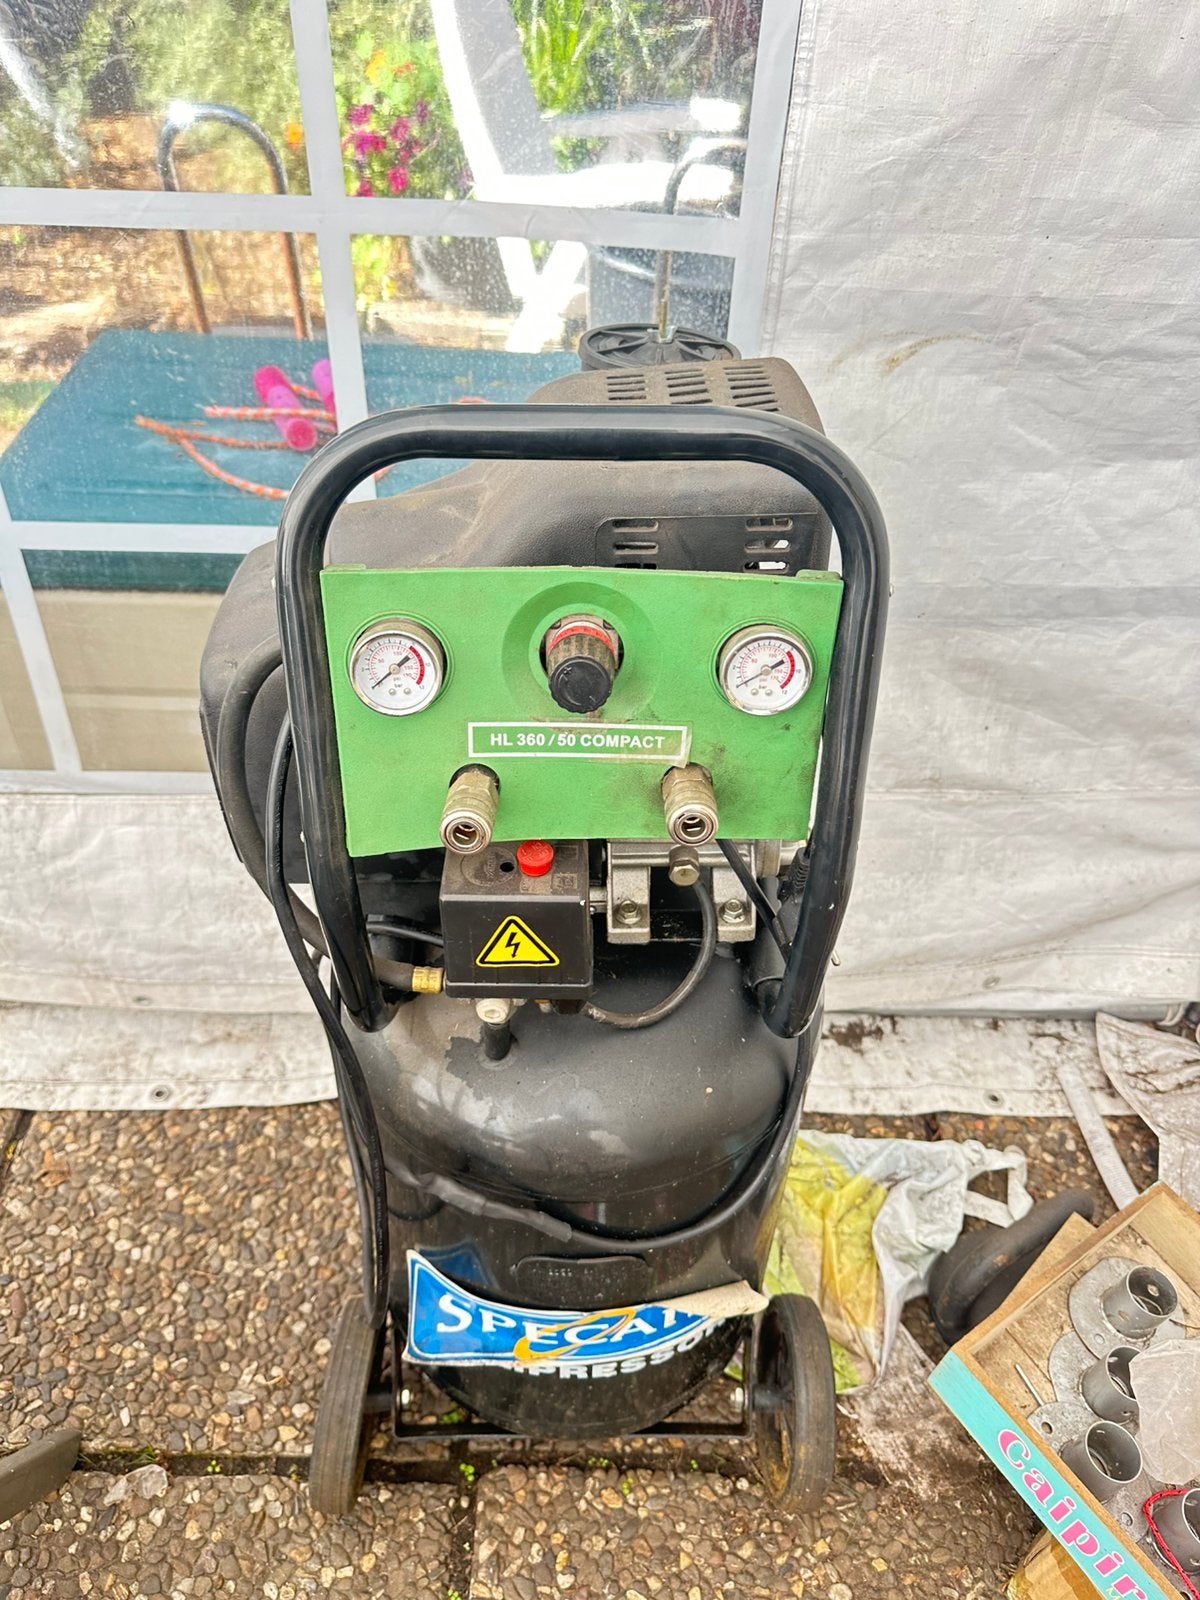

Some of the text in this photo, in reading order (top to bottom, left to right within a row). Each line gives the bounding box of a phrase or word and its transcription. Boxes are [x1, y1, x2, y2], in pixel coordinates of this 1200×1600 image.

[490, 733, 513, 746] HL
[517, 733, 545, 747] 360
[557, 734, 576, 747] 50
[580, 734, 665, 749] COMPACT
